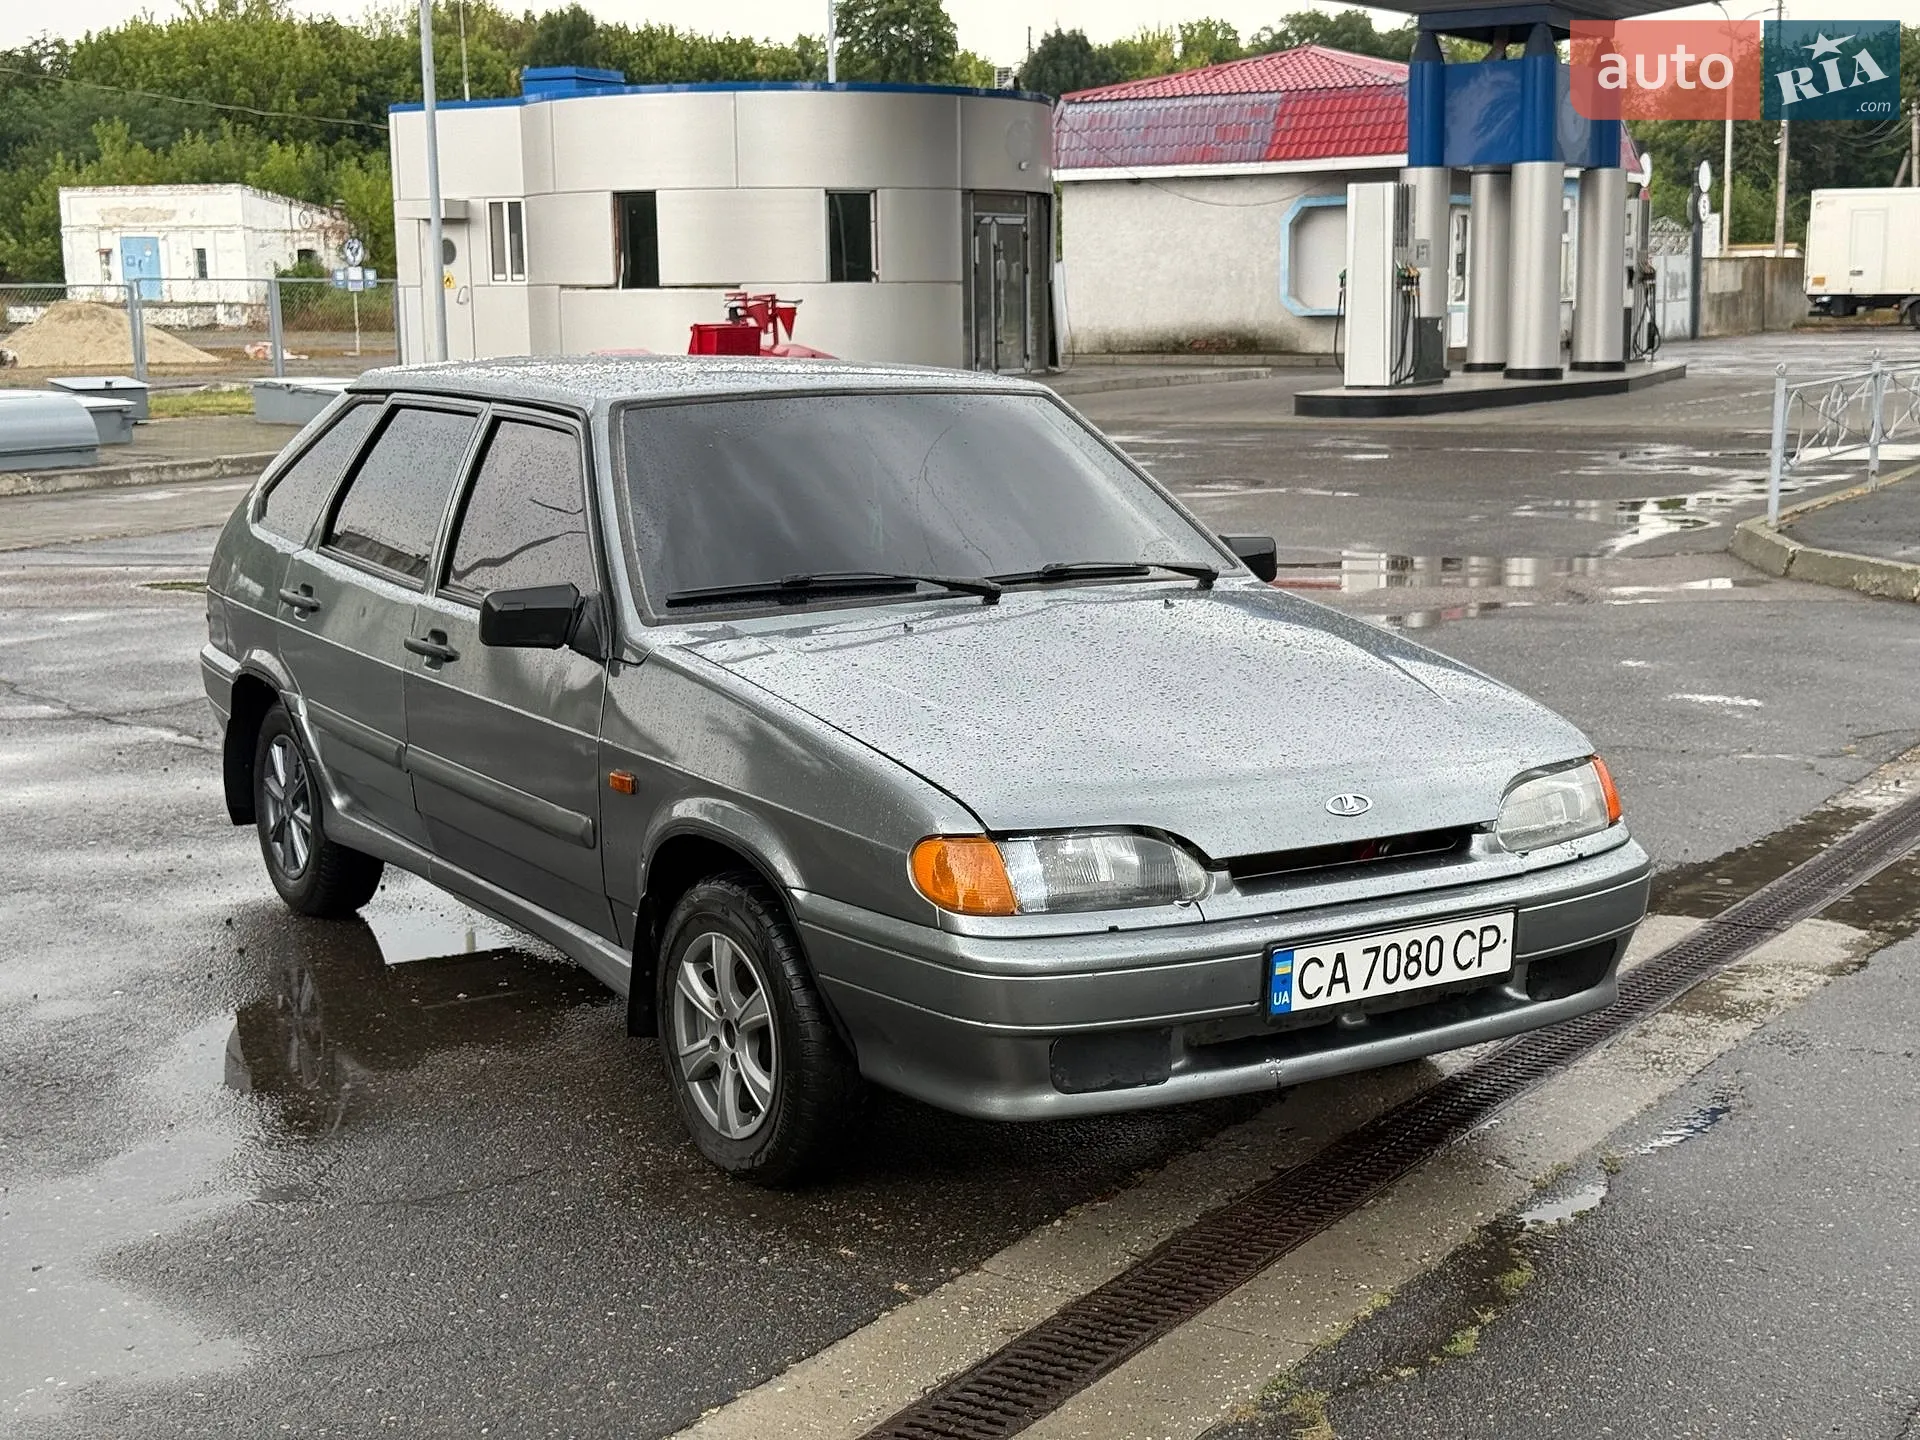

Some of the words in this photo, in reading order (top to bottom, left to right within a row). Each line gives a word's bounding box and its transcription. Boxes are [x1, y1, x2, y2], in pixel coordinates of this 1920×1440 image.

[1298, 952, 1350, 999] CA
[1362, 935, 1444, 990] 7080
[1453, 924, 1501, 970] CP
[1273, 991, 1290, 1006] UA
